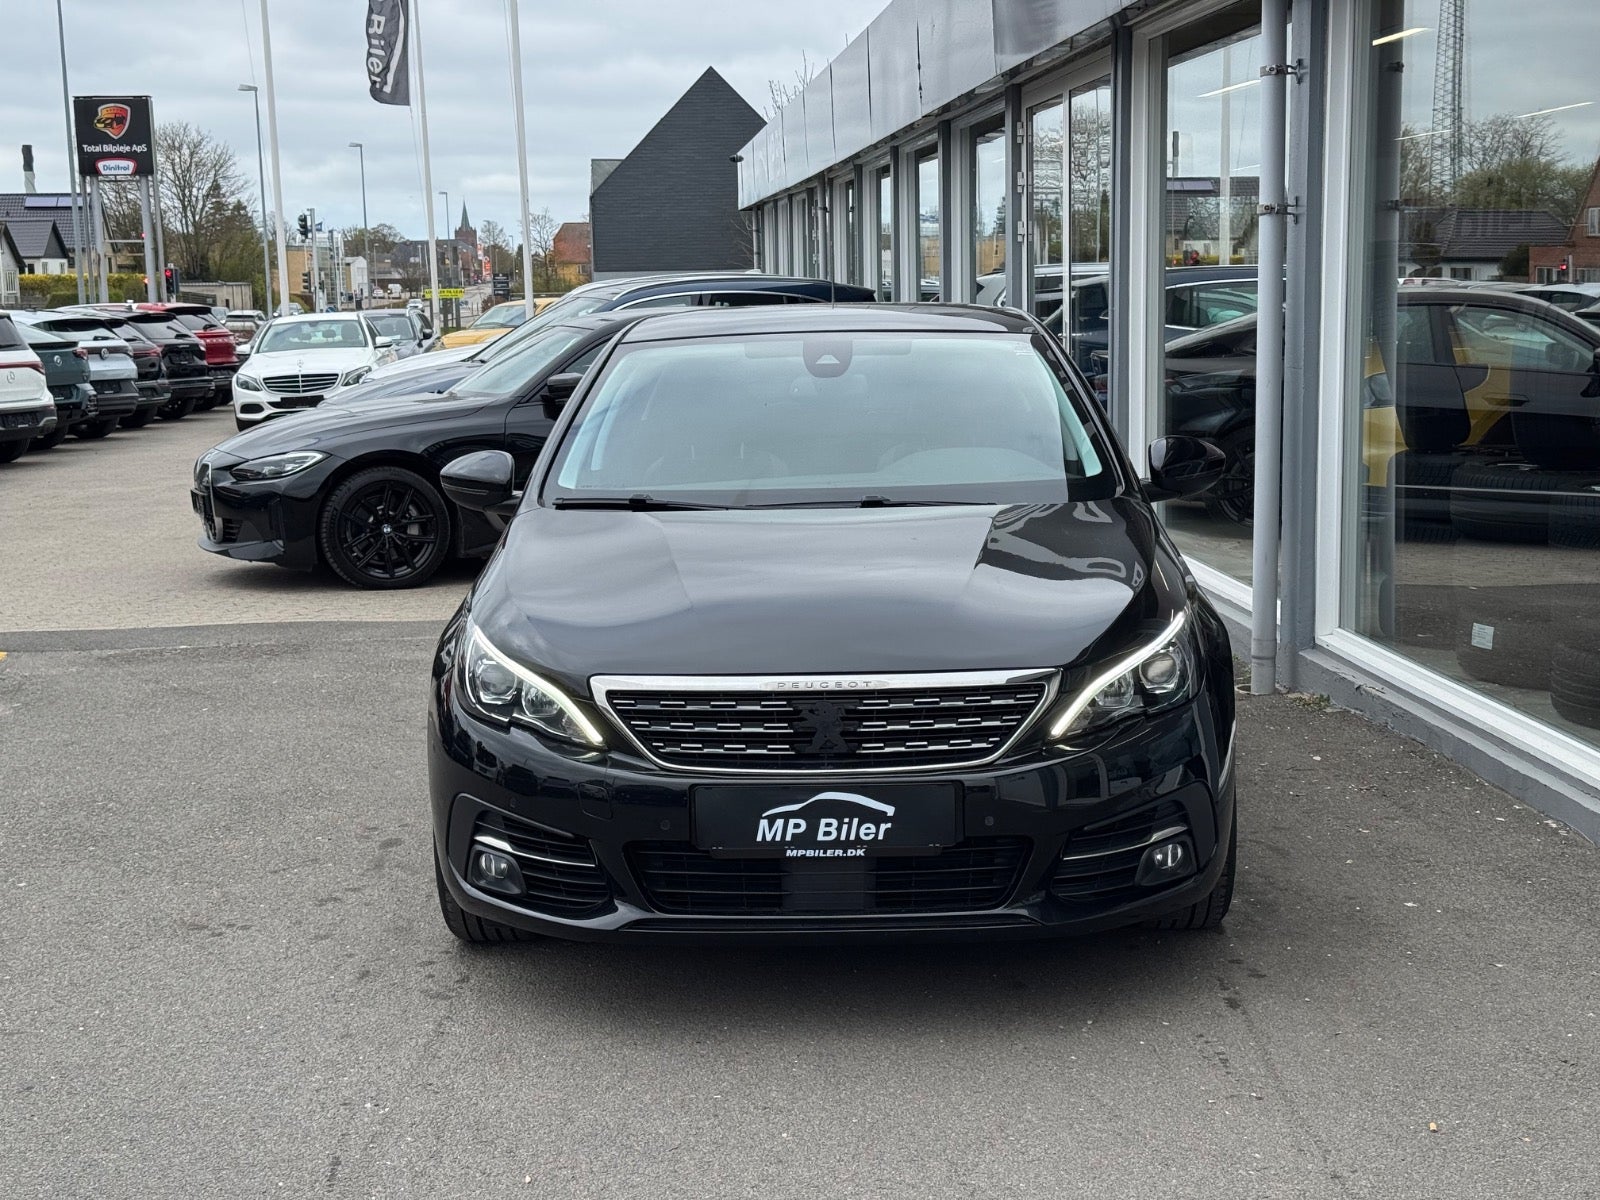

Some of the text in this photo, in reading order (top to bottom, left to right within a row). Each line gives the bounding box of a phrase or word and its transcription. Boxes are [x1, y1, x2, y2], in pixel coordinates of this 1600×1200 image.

[82, 144, 148, 153] Total Bilpleje ApS
[778, 681, 872, 689] PEUGEOT
[756, 818, 891, 841] MP Biler
[786, 848, 866, 857] MPBILER.DK
